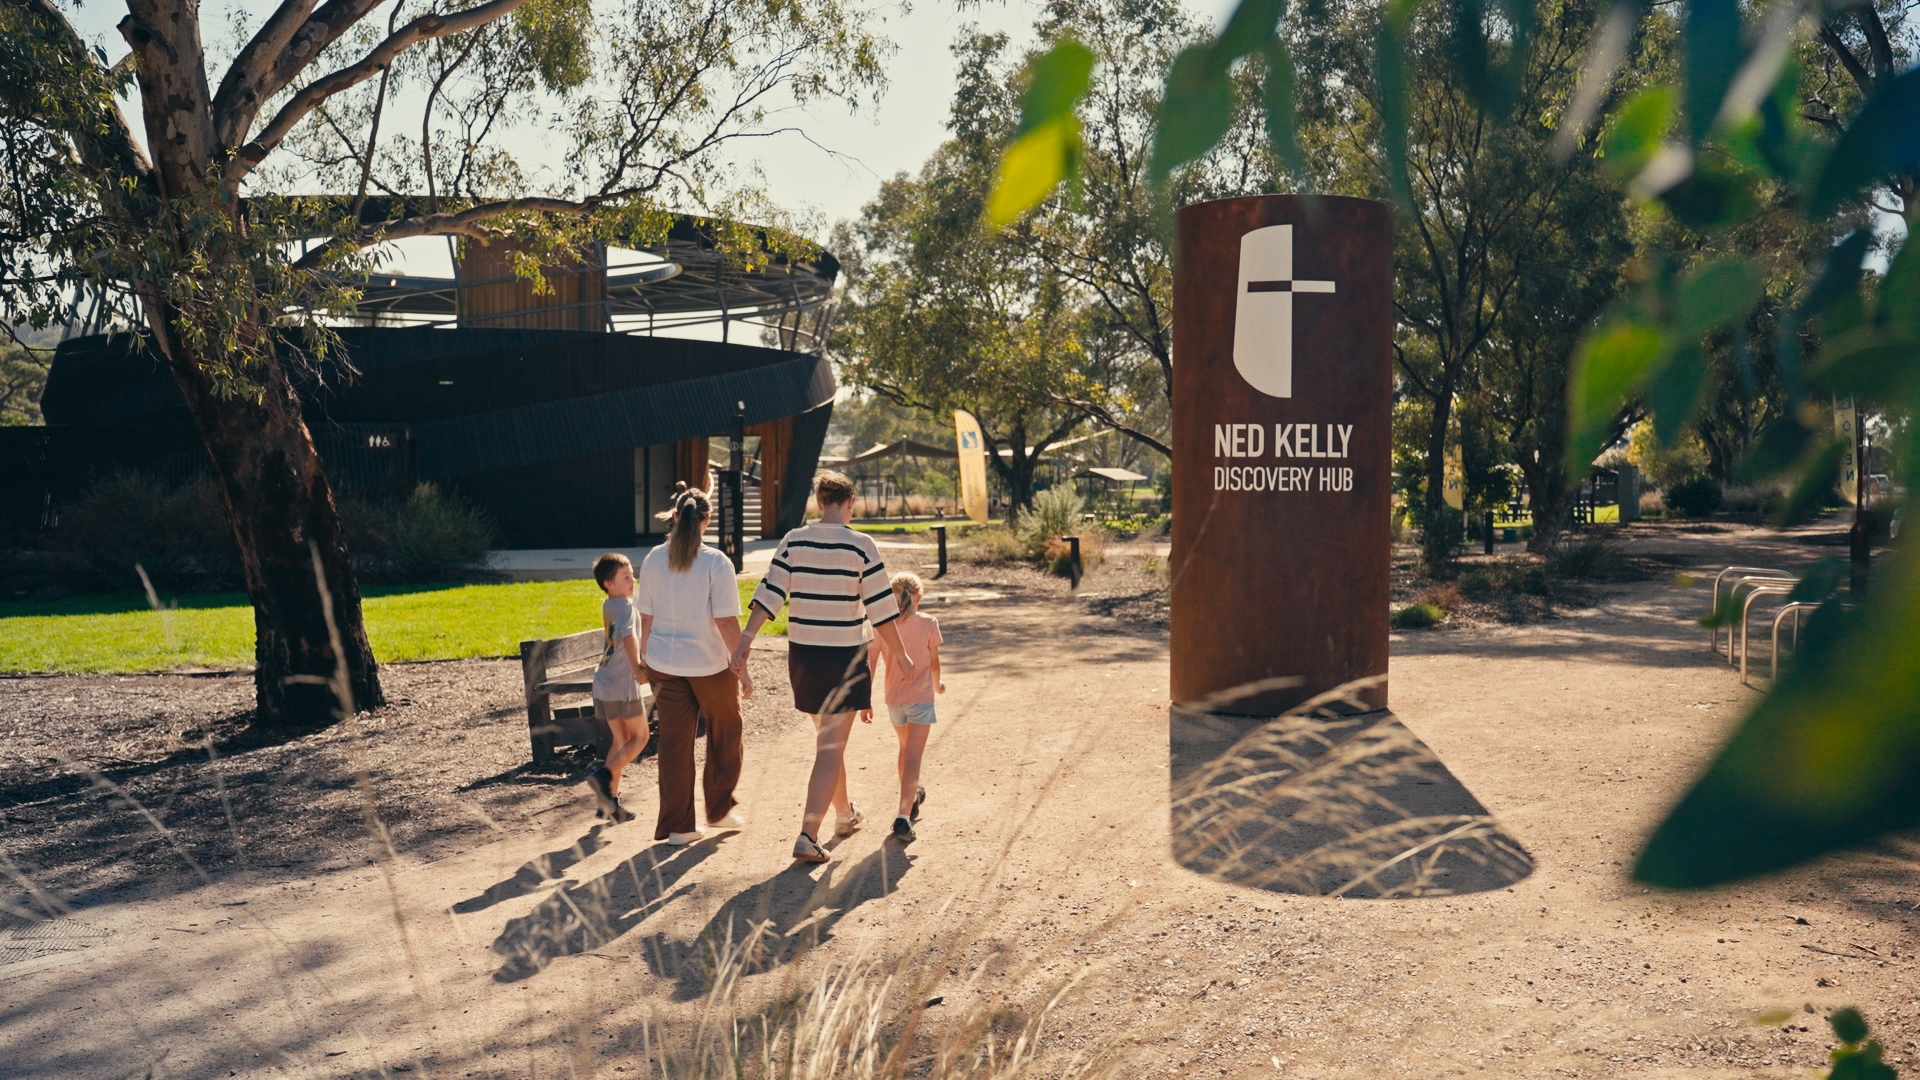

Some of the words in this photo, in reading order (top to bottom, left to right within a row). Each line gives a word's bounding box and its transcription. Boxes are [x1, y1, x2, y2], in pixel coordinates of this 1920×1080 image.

[1214, 423, 1265, 458] NED
[1275, 423, 1354, 458] KELLY
[1214, 466, 1314, 491] DISCOVERY
[1319, 466, 1353, 492] HUB
